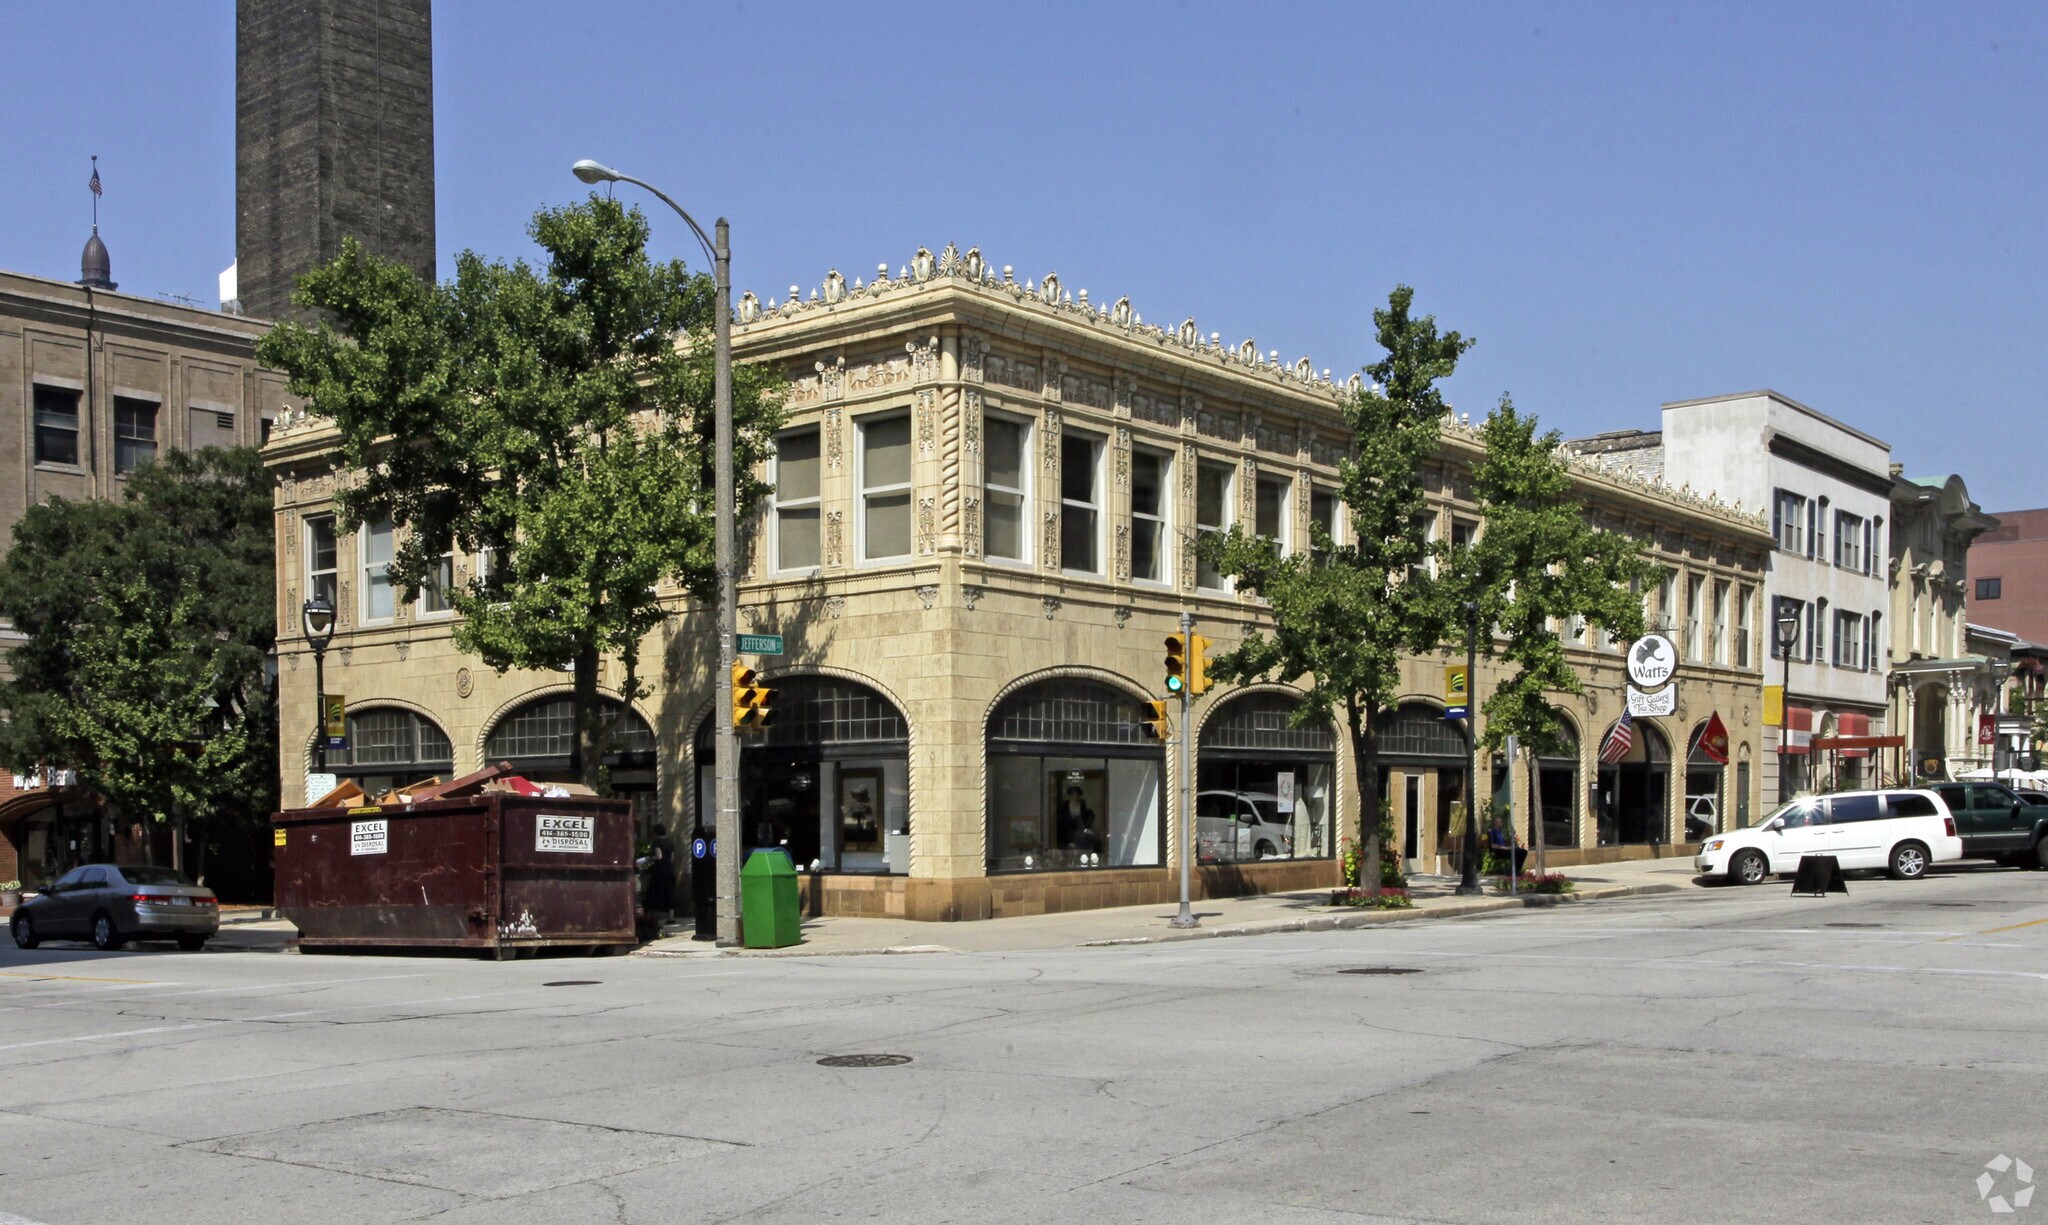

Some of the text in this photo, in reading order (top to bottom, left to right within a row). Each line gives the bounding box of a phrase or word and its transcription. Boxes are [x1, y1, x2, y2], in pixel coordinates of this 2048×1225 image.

[741, 637, 776, 651] JEFFERSON
[1633, 665, 1669, 679] Watts
[1630, 693, 1670, 704] Gift Gallery
[1633, 703, 1668, 714] Tea Shop
[47, 766, 77, 786] Bank
[355, 823, 384, 833] EXCEL
[543, 819, 588, 829] EXCEL
[361, 840, 384, 848] DISPOSAL
[552, 838, 588, 846] DISPOSAL
[696, 843, 703, 854] P
